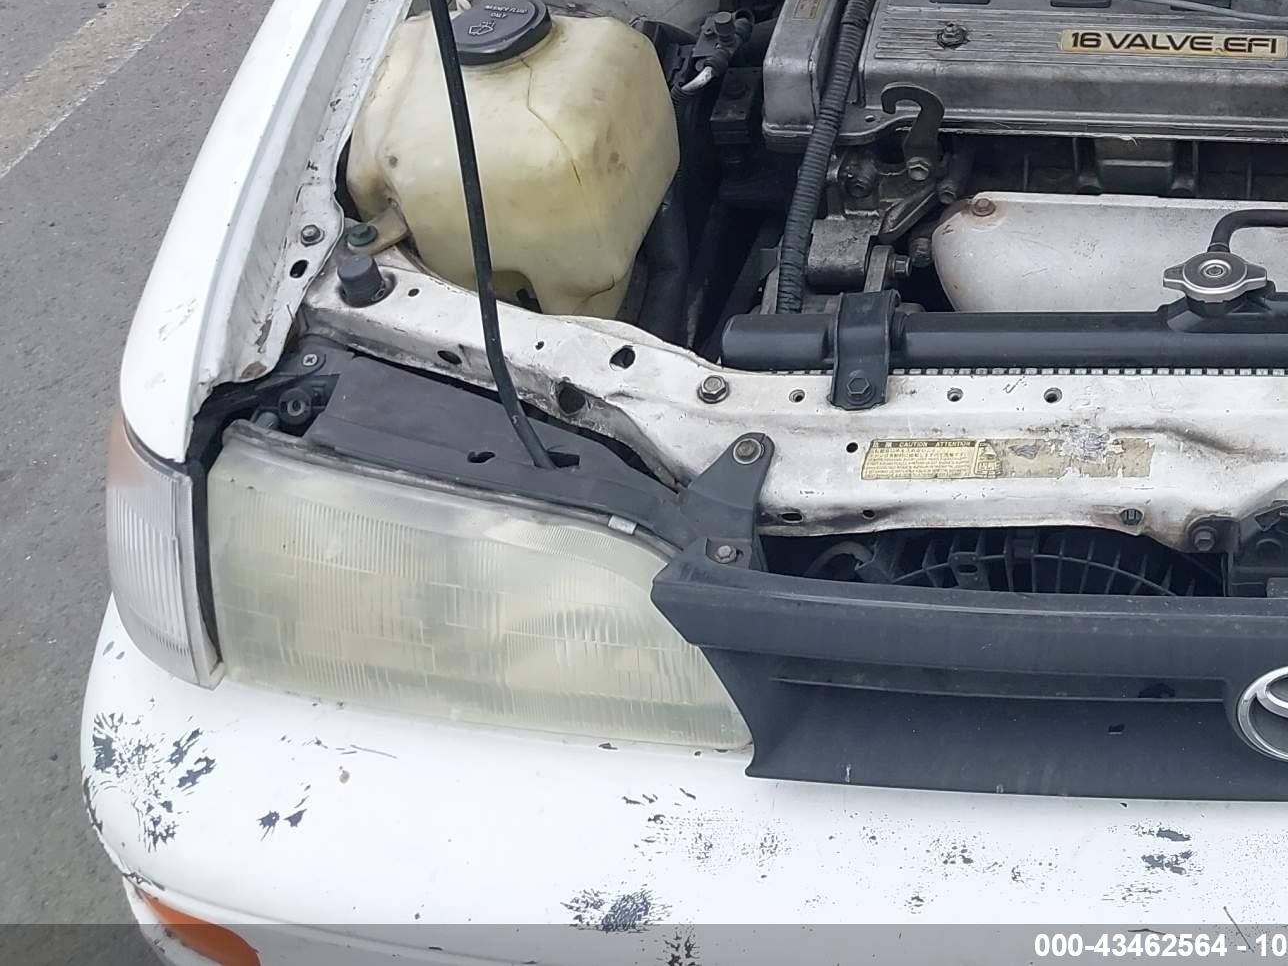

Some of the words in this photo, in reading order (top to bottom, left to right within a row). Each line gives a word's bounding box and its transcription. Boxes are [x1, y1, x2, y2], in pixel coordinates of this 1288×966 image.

[1071, 32, 1101, 48] 16
[1106, 32, 1214, 52] VALVE
[1223, 36, 1277, 54] EFI
